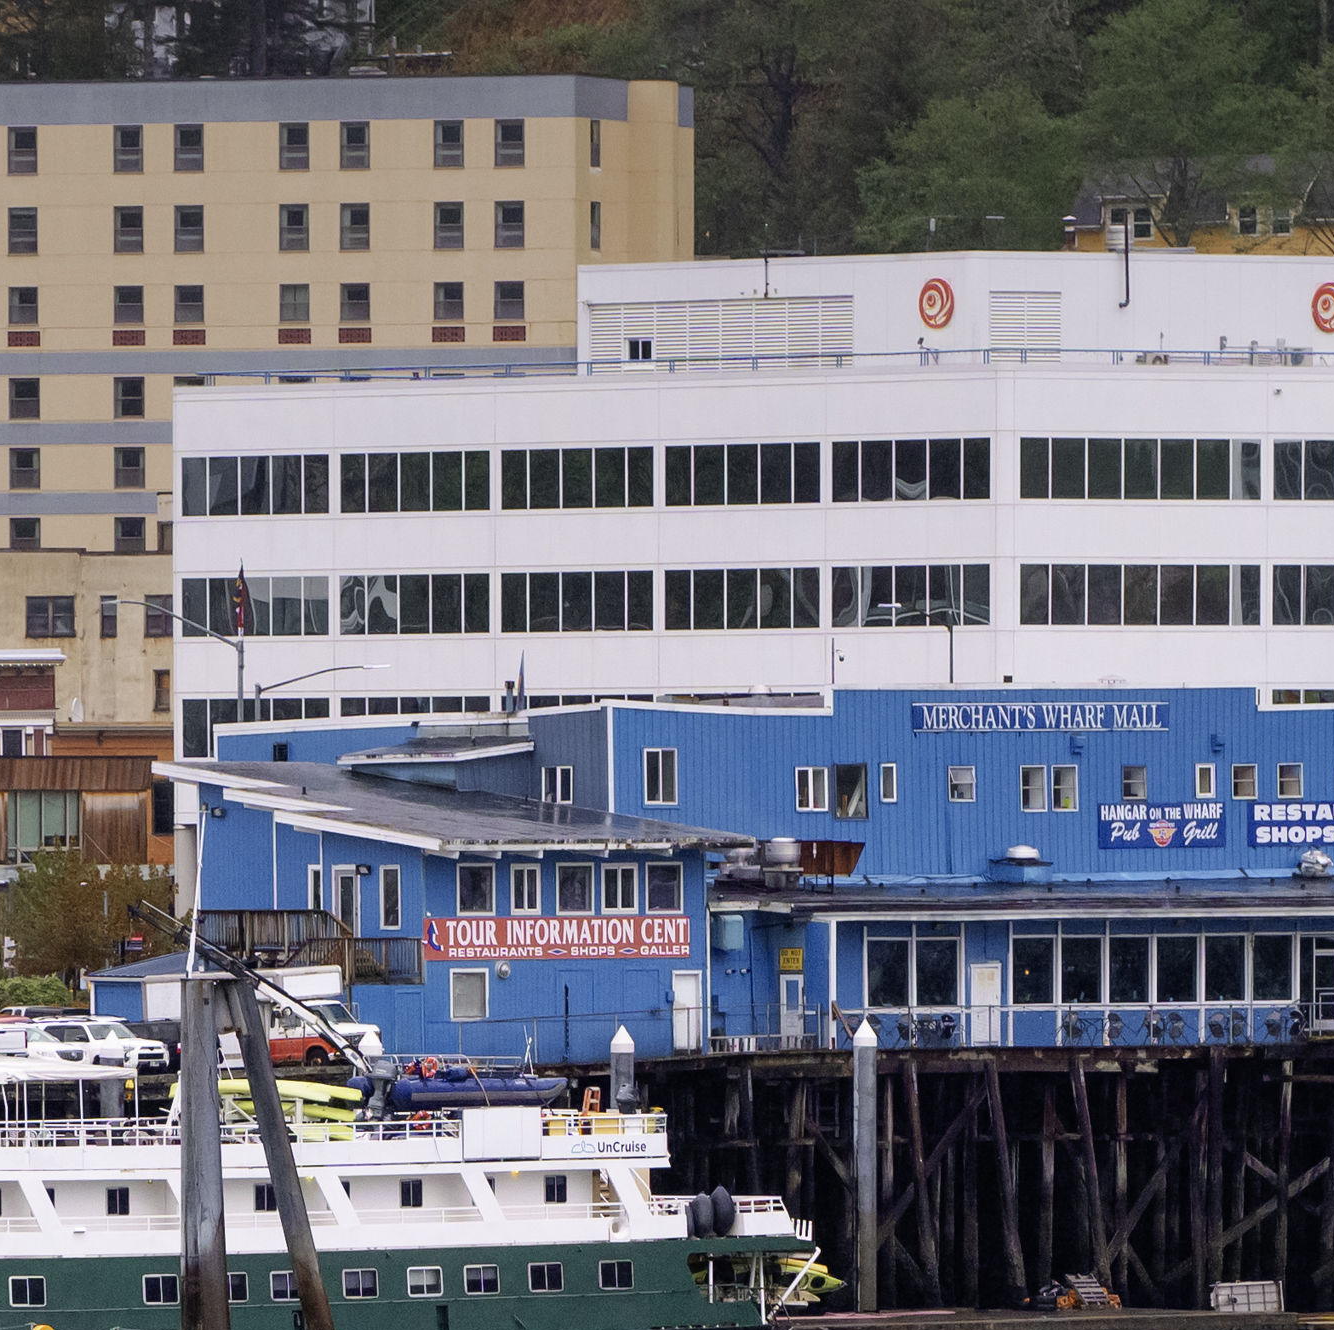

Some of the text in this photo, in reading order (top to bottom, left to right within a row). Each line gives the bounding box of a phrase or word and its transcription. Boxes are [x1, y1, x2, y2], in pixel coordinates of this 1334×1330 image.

[922, 704, 1162, 730] MERCHANT'S WHARF MALL
[1100, 803, 1223, 821] HANGAR ON THE WHARF
[1110, 822, 1141, 842] Pub
[1183, 821, 1218, 845] Grill
[446, 918, 690, 946] TOUR INFORMATION CENT
[448, 945, 690, 957] RESTAURANTS SHOPS GALLER
[598, 1140, 647, 1153] UnCruise
